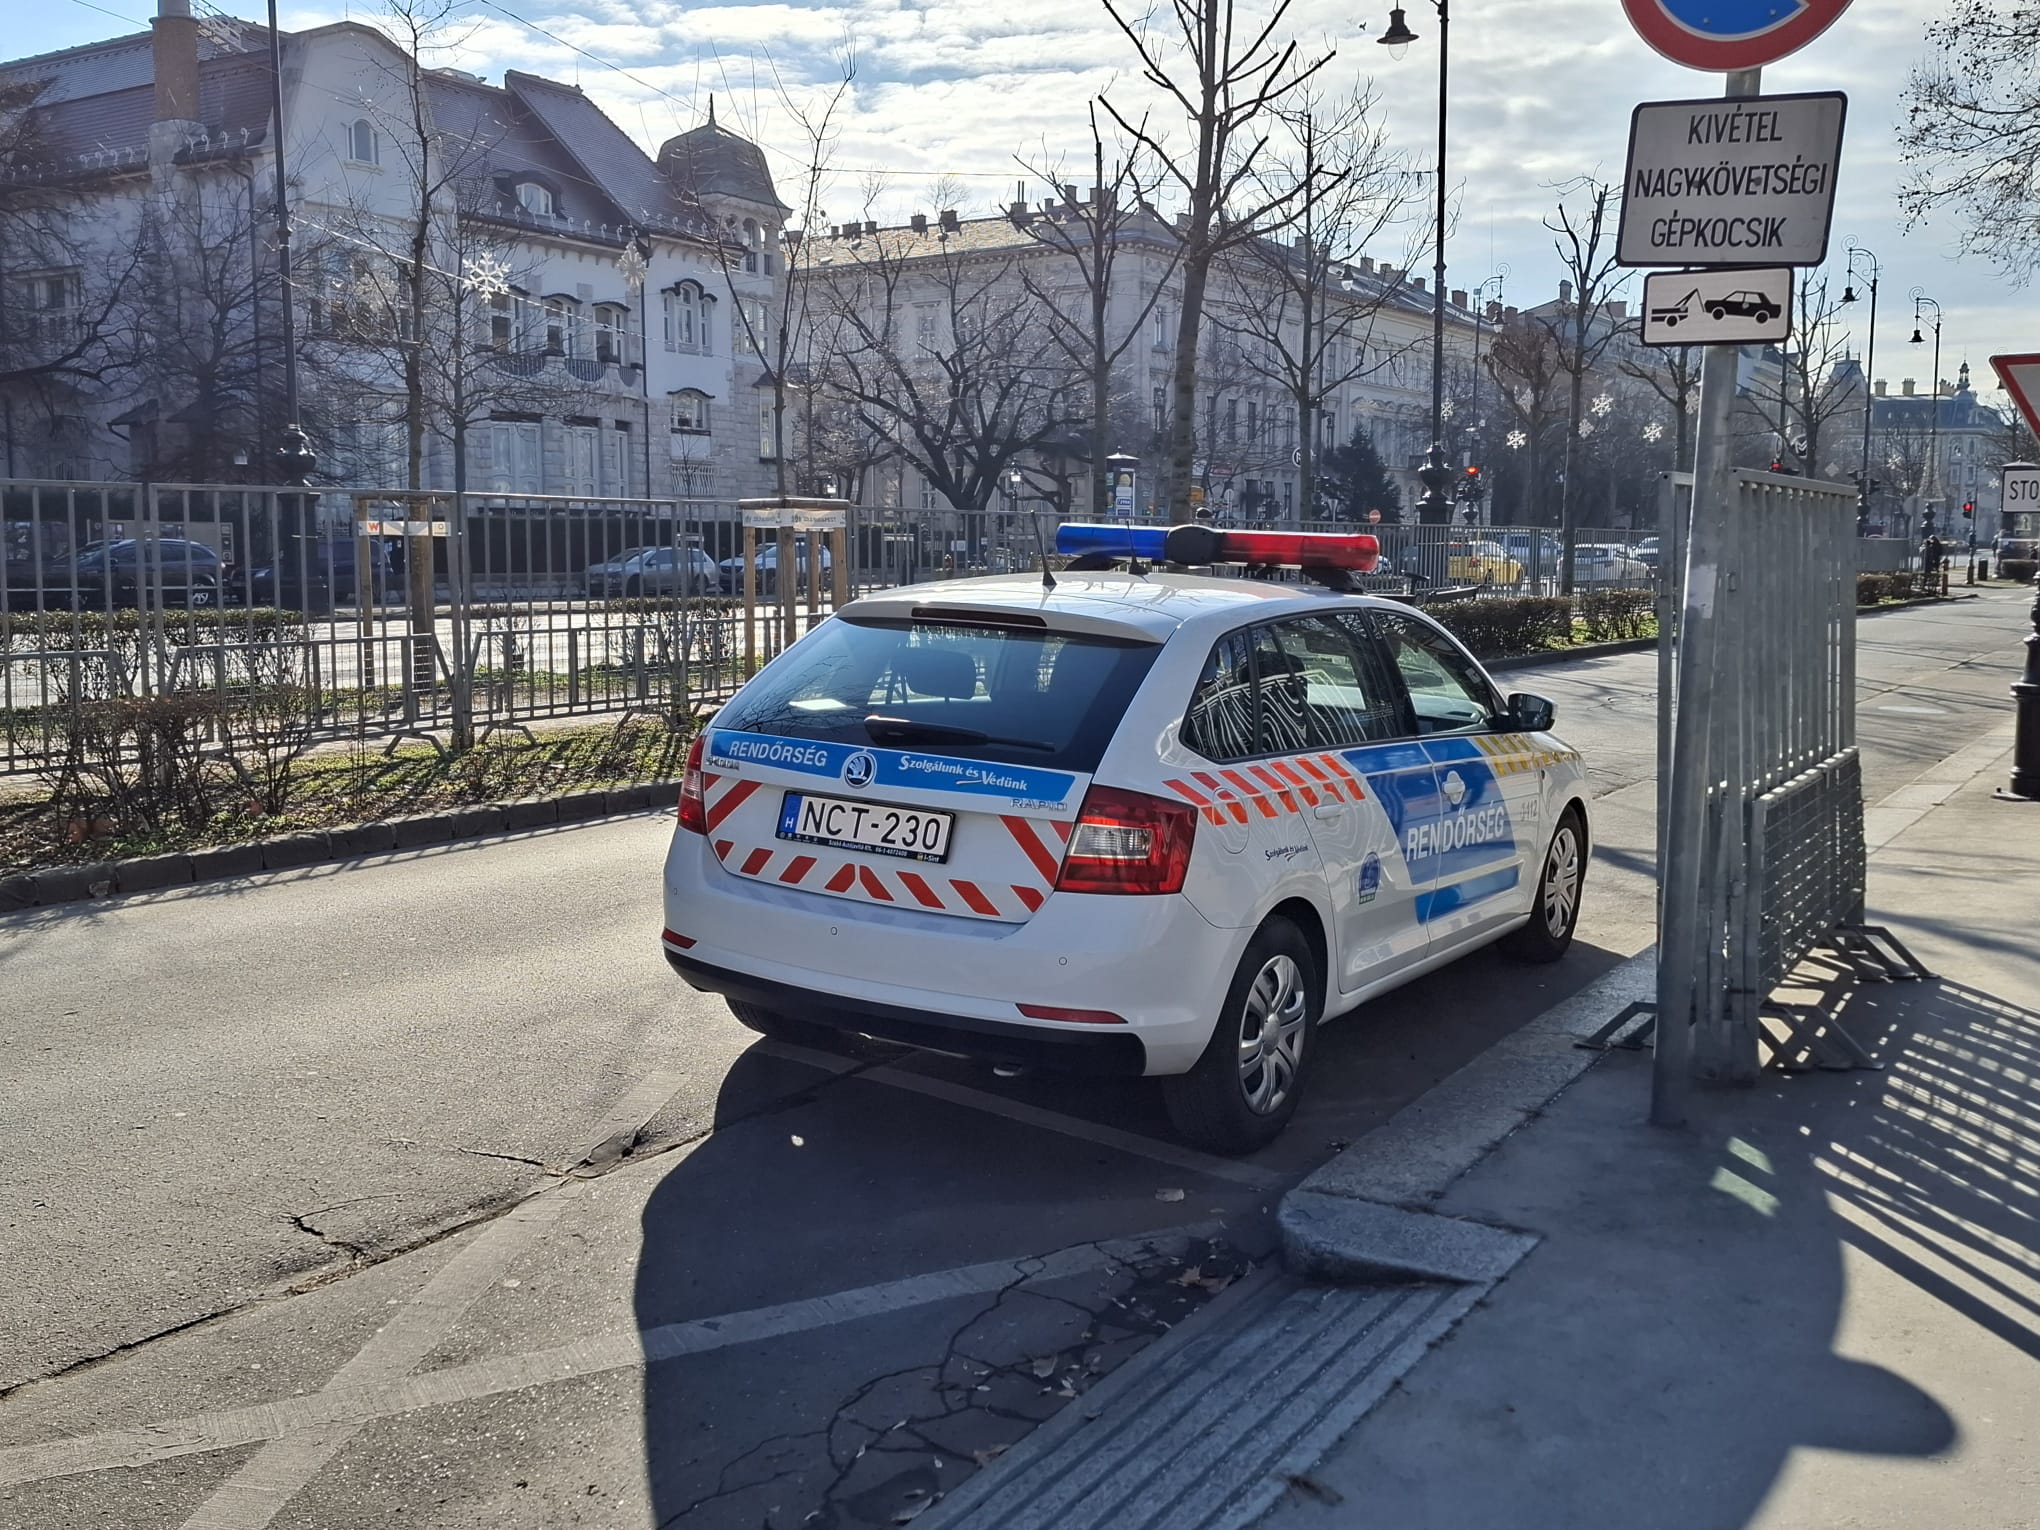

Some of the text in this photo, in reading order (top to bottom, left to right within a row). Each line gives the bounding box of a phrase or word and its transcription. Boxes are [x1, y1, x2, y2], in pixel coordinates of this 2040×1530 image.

[1688, 104, 1783, 144] KIVÉTEL
[1634, 154, 1828, 198] NAGYKÖVETSÉGI
[1651, 210, 1787, 247] GÉPKOCSIK
[729, 741, 828, 767] RENDŐRSÉG
[898, 755, 1028, 791] Szolgálunk és Védünk
[785, 801, 941, 850] H NCT-230
[1406, 800, 1505, 862] RENDŐRSÉG
